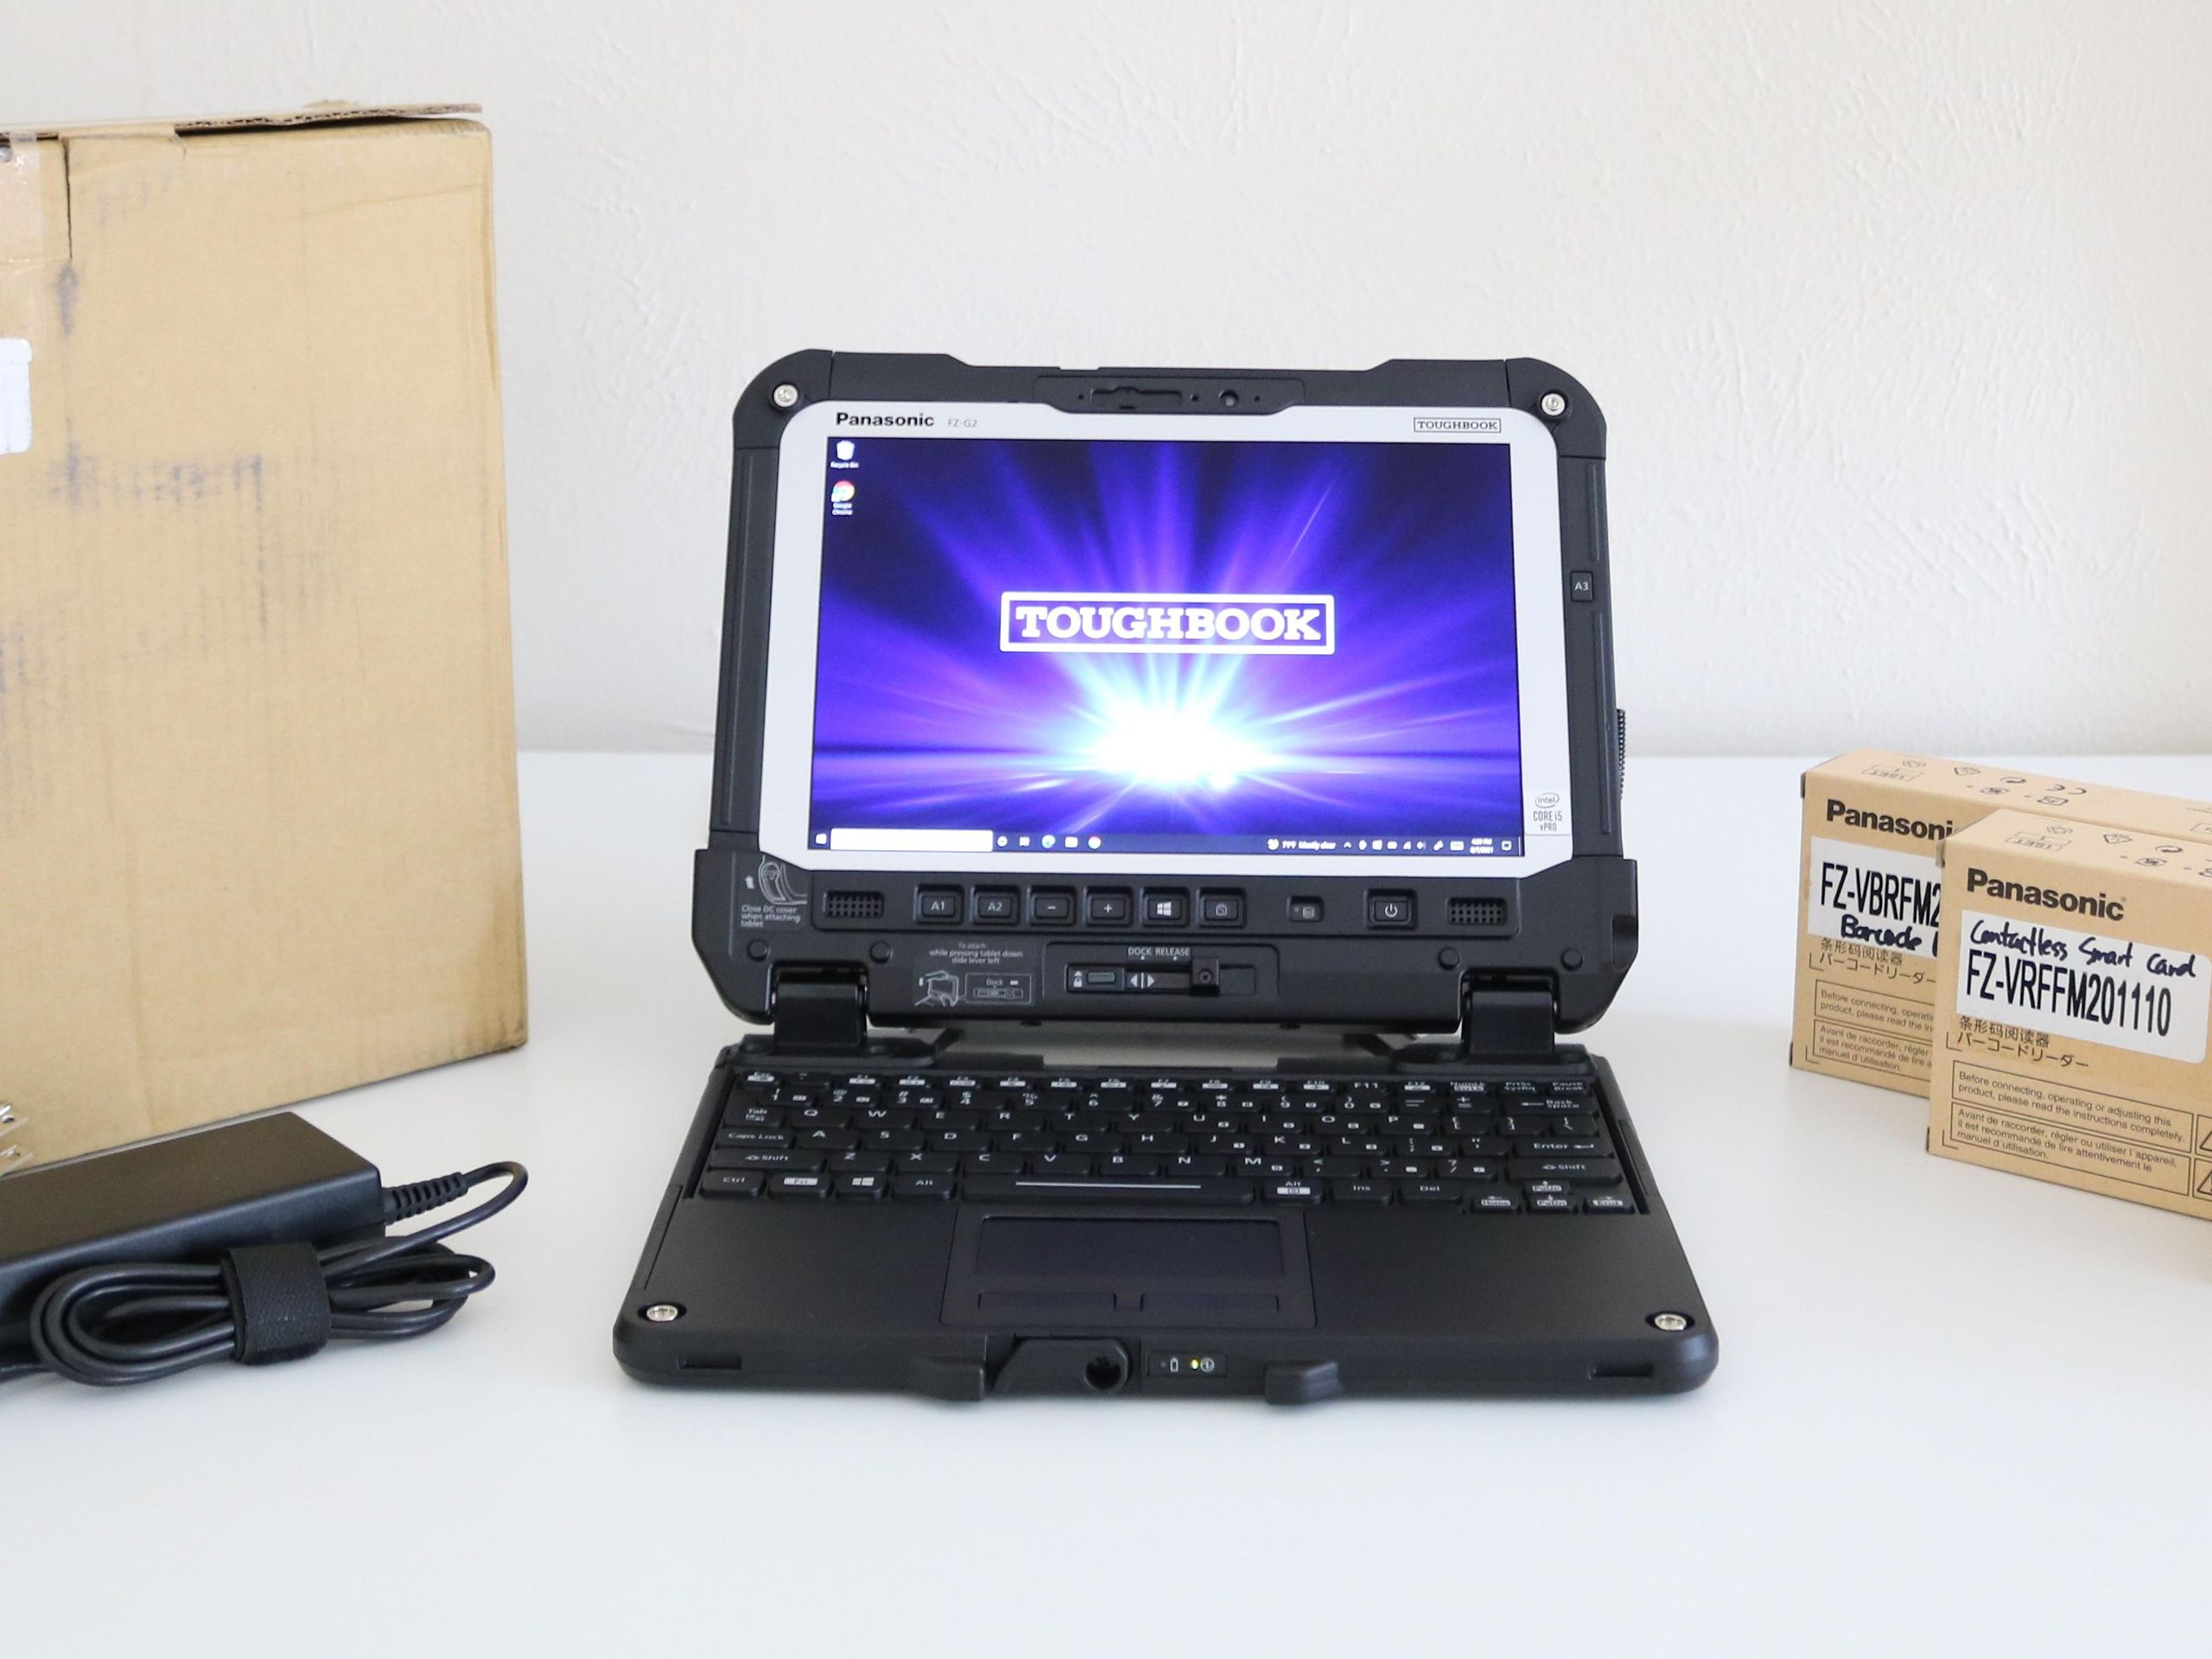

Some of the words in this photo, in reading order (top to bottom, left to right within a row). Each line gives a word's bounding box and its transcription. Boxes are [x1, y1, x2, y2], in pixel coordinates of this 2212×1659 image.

[836, 412, 934, 426] Panasonic
[1417, 421, 1497, 430] TOUGHBOOK
[1574, 582, 1589, 591] A3
[1015, 606, 1321, 640] TOUGHBOOK
[1533, 810, 1553, 822] CORE
[1554, 810, 1563, 822] i5
[1539, 823, 1557, 831] vPRO
[931, 901, 945, 911] A1
[988, 902, 1002, 912] A2
[1967, 868, 2125, 921] Panasonic
[1840, 914, 1923, 950] Barcode
[1128, 947, 1152, 956] DOCK
[1155, 947, 1191, 957] RELEASE
[2078, 938, 2133, 968] Smart
[2146, 953, 2196, 977] Card
[1819, 952, 1936, 984] バーコードリーダー
[1821, 989, 1848, 1003] Before
[1851, 998, 1899, 1015] connecting,
[1967, 949, 2171, 1037] FZ-VRFFM201110
[1820, 1002, 1854, 1017] product,
[1856, 1010, 1885, 1022] please
[1887, 1016, 1906, 1027] read
[1908, 1020, 1923, 1030] the
[1820, 1025, 1845, 1038] Avant
[1846, 1031, 1858, 1041] de
[1904, 1045, 1929, 1058] régler
[1958, 1015, 2050, 1049] 条形码阅读器
[1819, 1046, 1850, 1059] manuel
[1826, 1039, 1839, 1047] est
[1840, 1042, 1897, 1061] recommandé
[1898, 1052, 1910, 1064] de
[1911, 1055, 1924, 1066] lire
[1957, 1032, 2088, 1067] バーコードリーダー
[1958, 1084, 1995, 1099] product,
[1998, 1092, 2029, 1107] please
[2031, 1100, 2053, 1112] read
[2055, 1105, 2070, 1116] the
[2073, 1110, 2127, 1129] instructions
[2130, 1123, 2185, 1142] completely.
[1959, 1071, 1989, 1085] Before
[1992, 1080, 2045, 1100] connecting,
[2047, 1092, 2093, 1110] operating
[2094, 1103, 2106, 1112] or
[2107, 1107, 2152, 1124] adjusting
[2153, 1115, 2171, 1127] this
[1274, 1135, 1286, 1144] K
[1957, 1130, 1991, 1145] manuel
[1958, 1108, 1985, 1122] Avant
[1986, 1114, 1999, 1125] de
[2050, 1131, 2078, 1144] régler
[2080, 1138, 2093, 1147] ou
[2095, 1141, 2126, 1155] utiliser
[1964, 1122, 1980, 1132] est
[1980, 1126, 2042, 1145] recommandé
[2044, 1140, 2056, 1150] de
[2058, 1143, 2074, 1154] lire
[2075, 1147, 2141, 1171] attentivement
[2143, 1163, 2152, 1172] le
